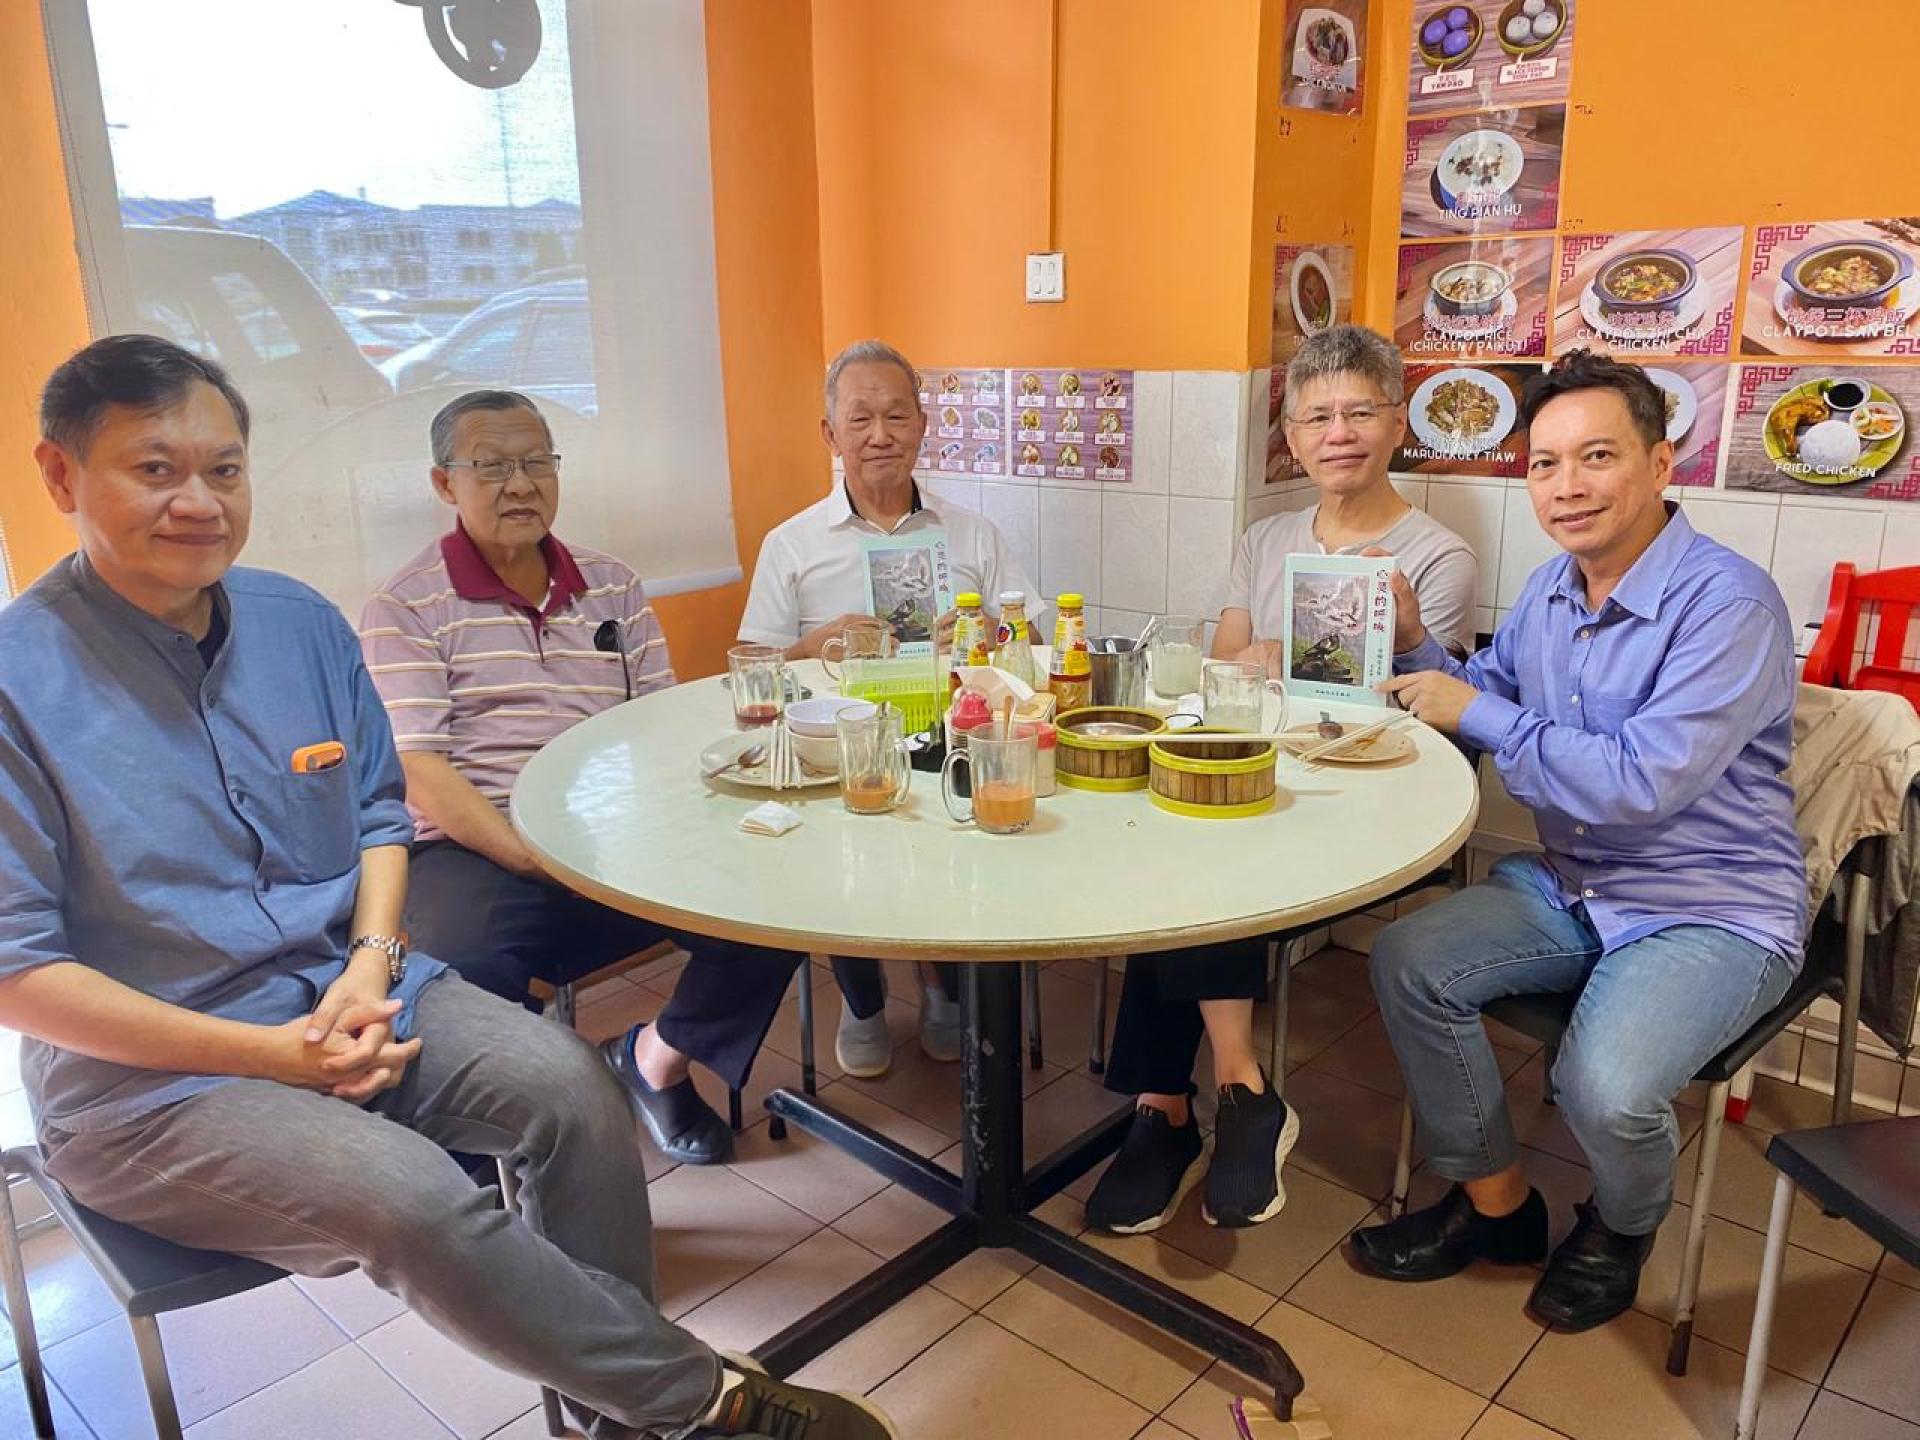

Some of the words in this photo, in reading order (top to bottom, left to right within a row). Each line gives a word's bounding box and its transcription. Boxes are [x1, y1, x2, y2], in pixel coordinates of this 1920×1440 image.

[1439, 208, 1468, 220] TING
[1471, 204, 1500, 218] PIAN
[1504, 203, 1521, 217] HU
[1424, 330, 1482, 341] CLAYPOT
[1484, 329, 1512, 341] RICE
[1576, 329, 1646, 340] CLAYPOT
[1762, 326, 1836, 337] CLAYPOT
[1845, 325, 1877, 337] SAN
[1608, 339, 1668, 351] CHICKEN
[1484, 450, 1516, 463] TIAW
[1775, 462, 1811, 473] FRIED
[1815, 464, 1876, 478] CHICKEN
